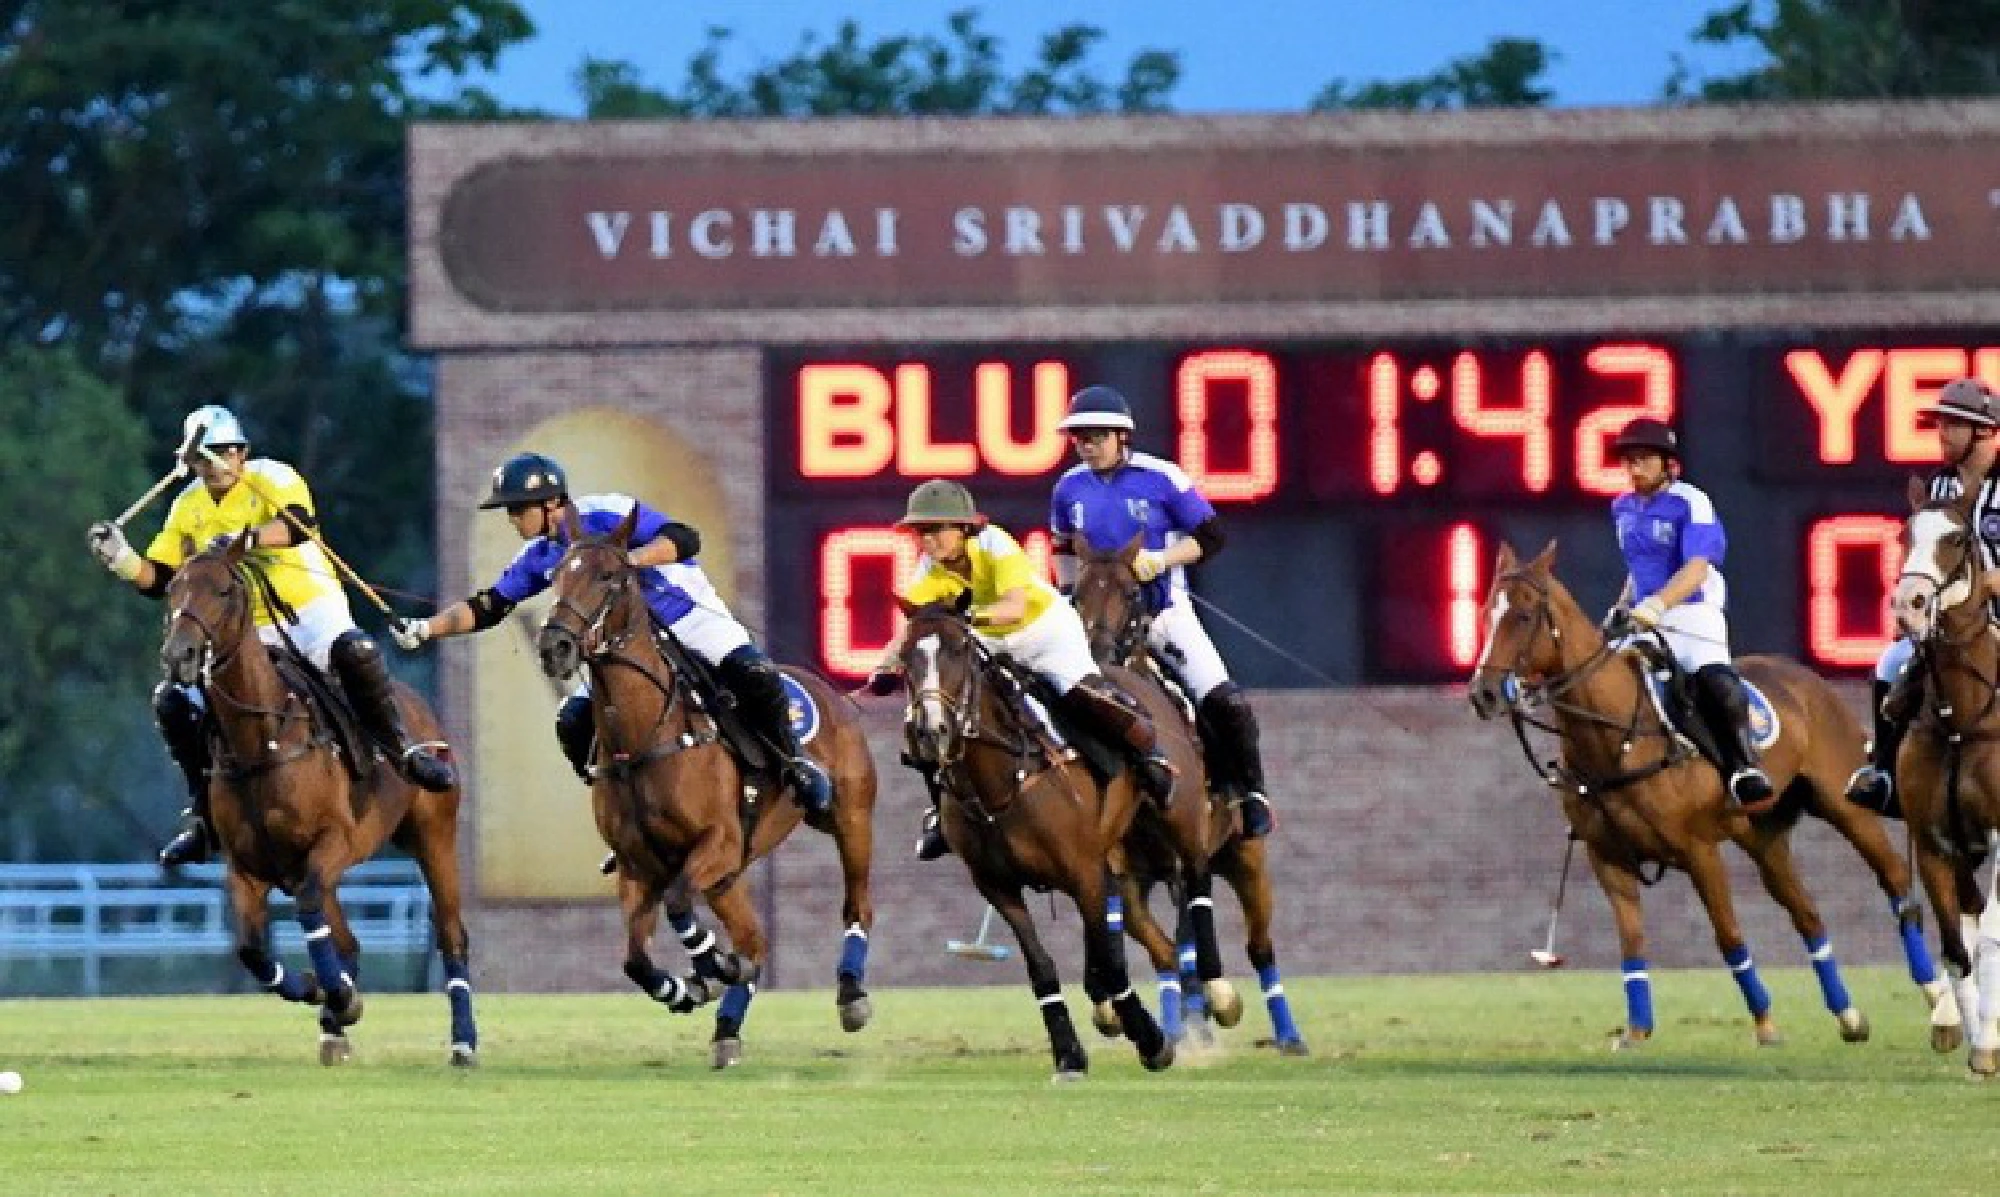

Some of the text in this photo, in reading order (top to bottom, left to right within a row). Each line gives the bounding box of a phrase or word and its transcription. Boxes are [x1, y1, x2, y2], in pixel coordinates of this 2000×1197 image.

[586, 191, 1932, 259] VICHAI SRIVADDHANAPRABHA
[798, 361, 1069, 478] BLU
[1446, 523, 1482, 670] 1
